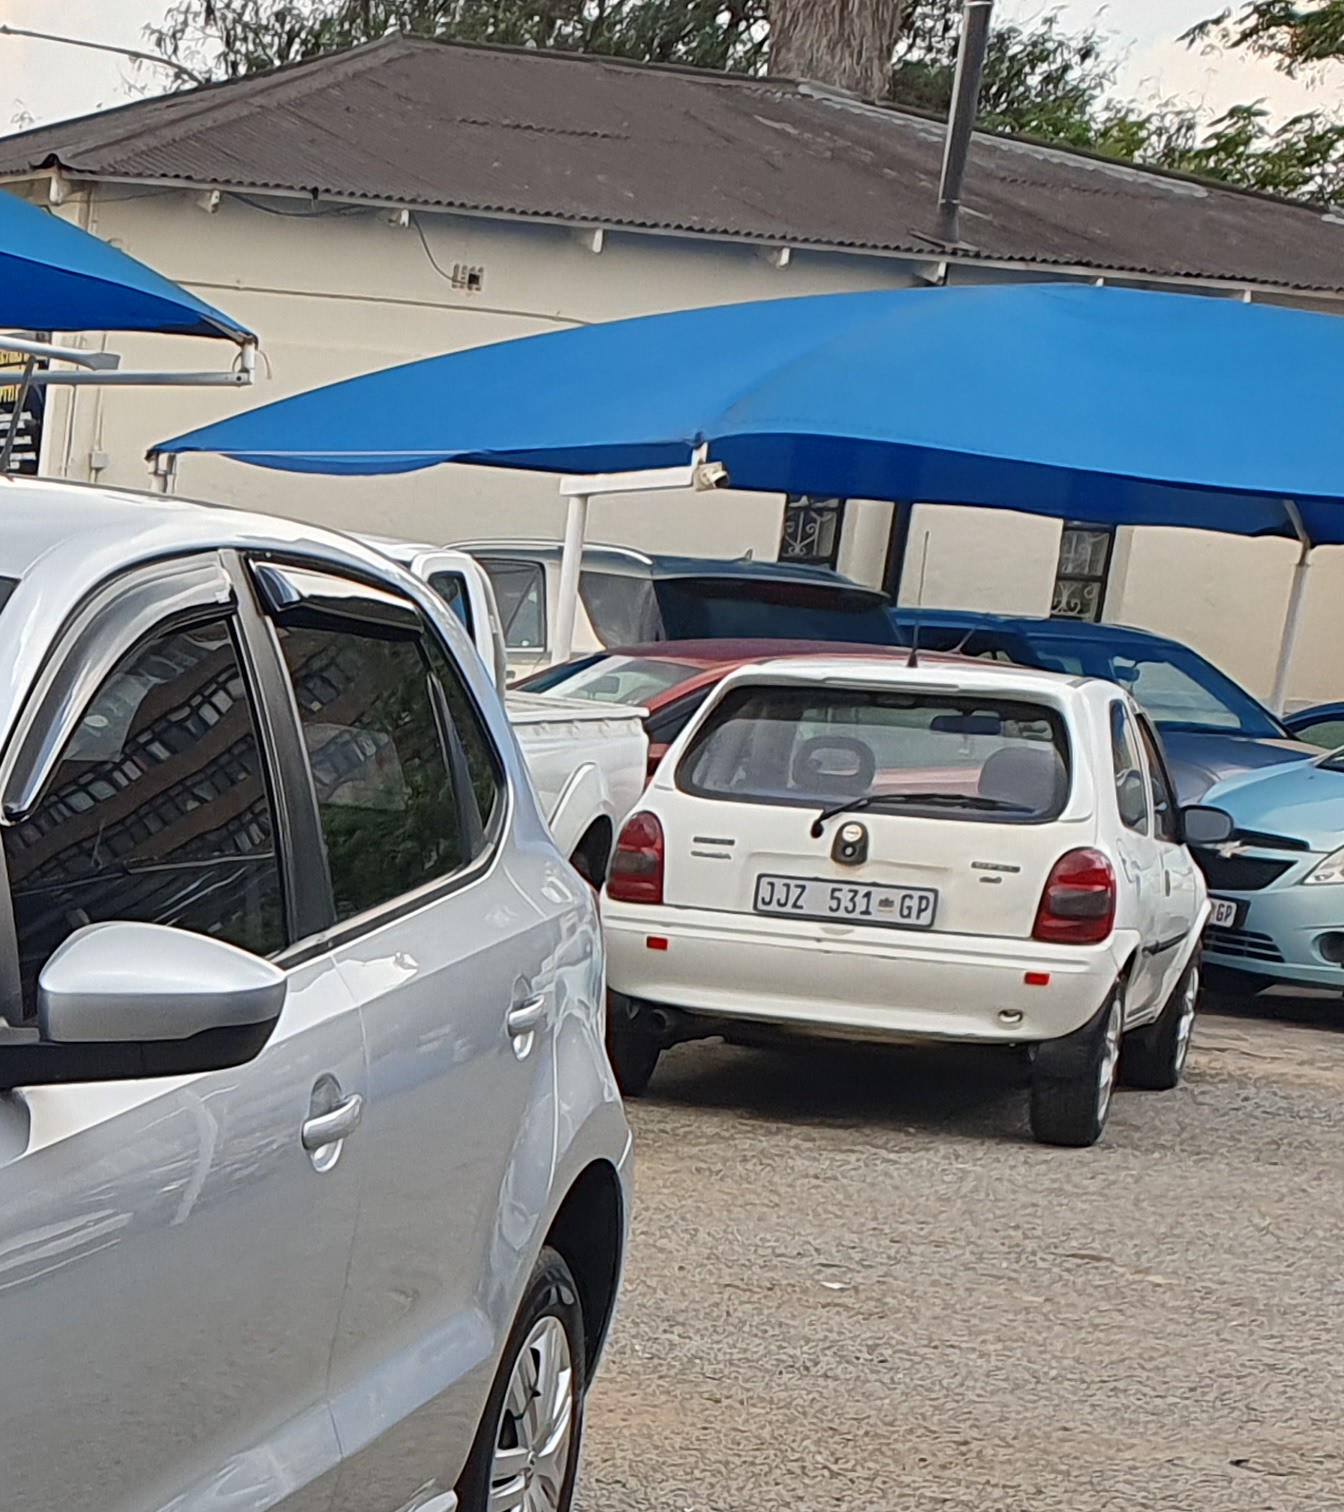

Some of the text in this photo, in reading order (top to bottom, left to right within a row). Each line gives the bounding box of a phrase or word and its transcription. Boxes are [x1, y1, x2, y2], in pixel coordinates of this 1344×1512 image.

[761, 881, 931, 920] JJZ 531 GP
[1215, 903, 1233, 923] GP
